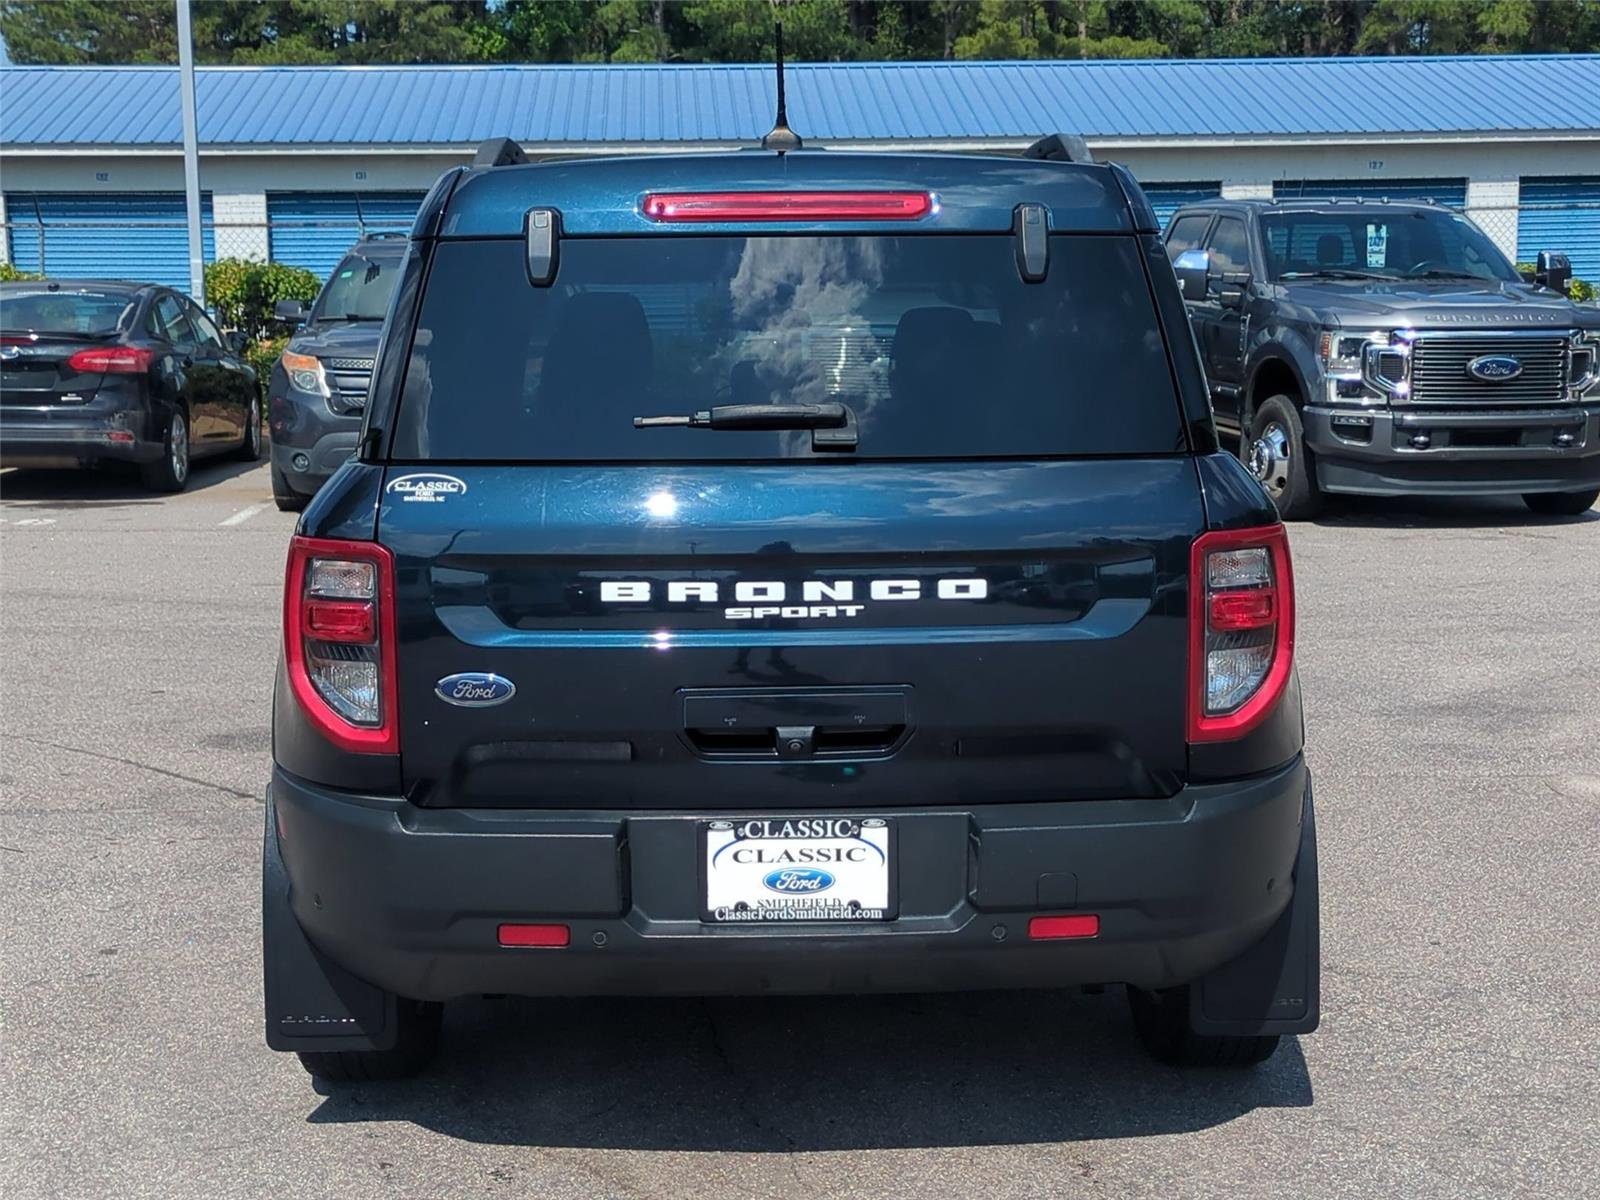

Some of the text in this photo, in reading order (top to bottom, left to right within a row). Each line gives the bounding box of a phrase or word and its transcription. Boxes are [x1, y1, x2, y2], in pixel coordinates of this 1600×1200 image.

[394, 481, 460, 491] CLASSIC
[600, 579, 988, 602] BRONCO
[724, 604, 865, 619] SPORT
[453, 680, 496, 698] Ford
[744, 819, 852, 839] CLASSIC
[732, 847, 867, 864] CLASSIC
[775, 870, 822, 890] Ford
[715, 906, 883, 921] ClassicFordSmithfield.com
